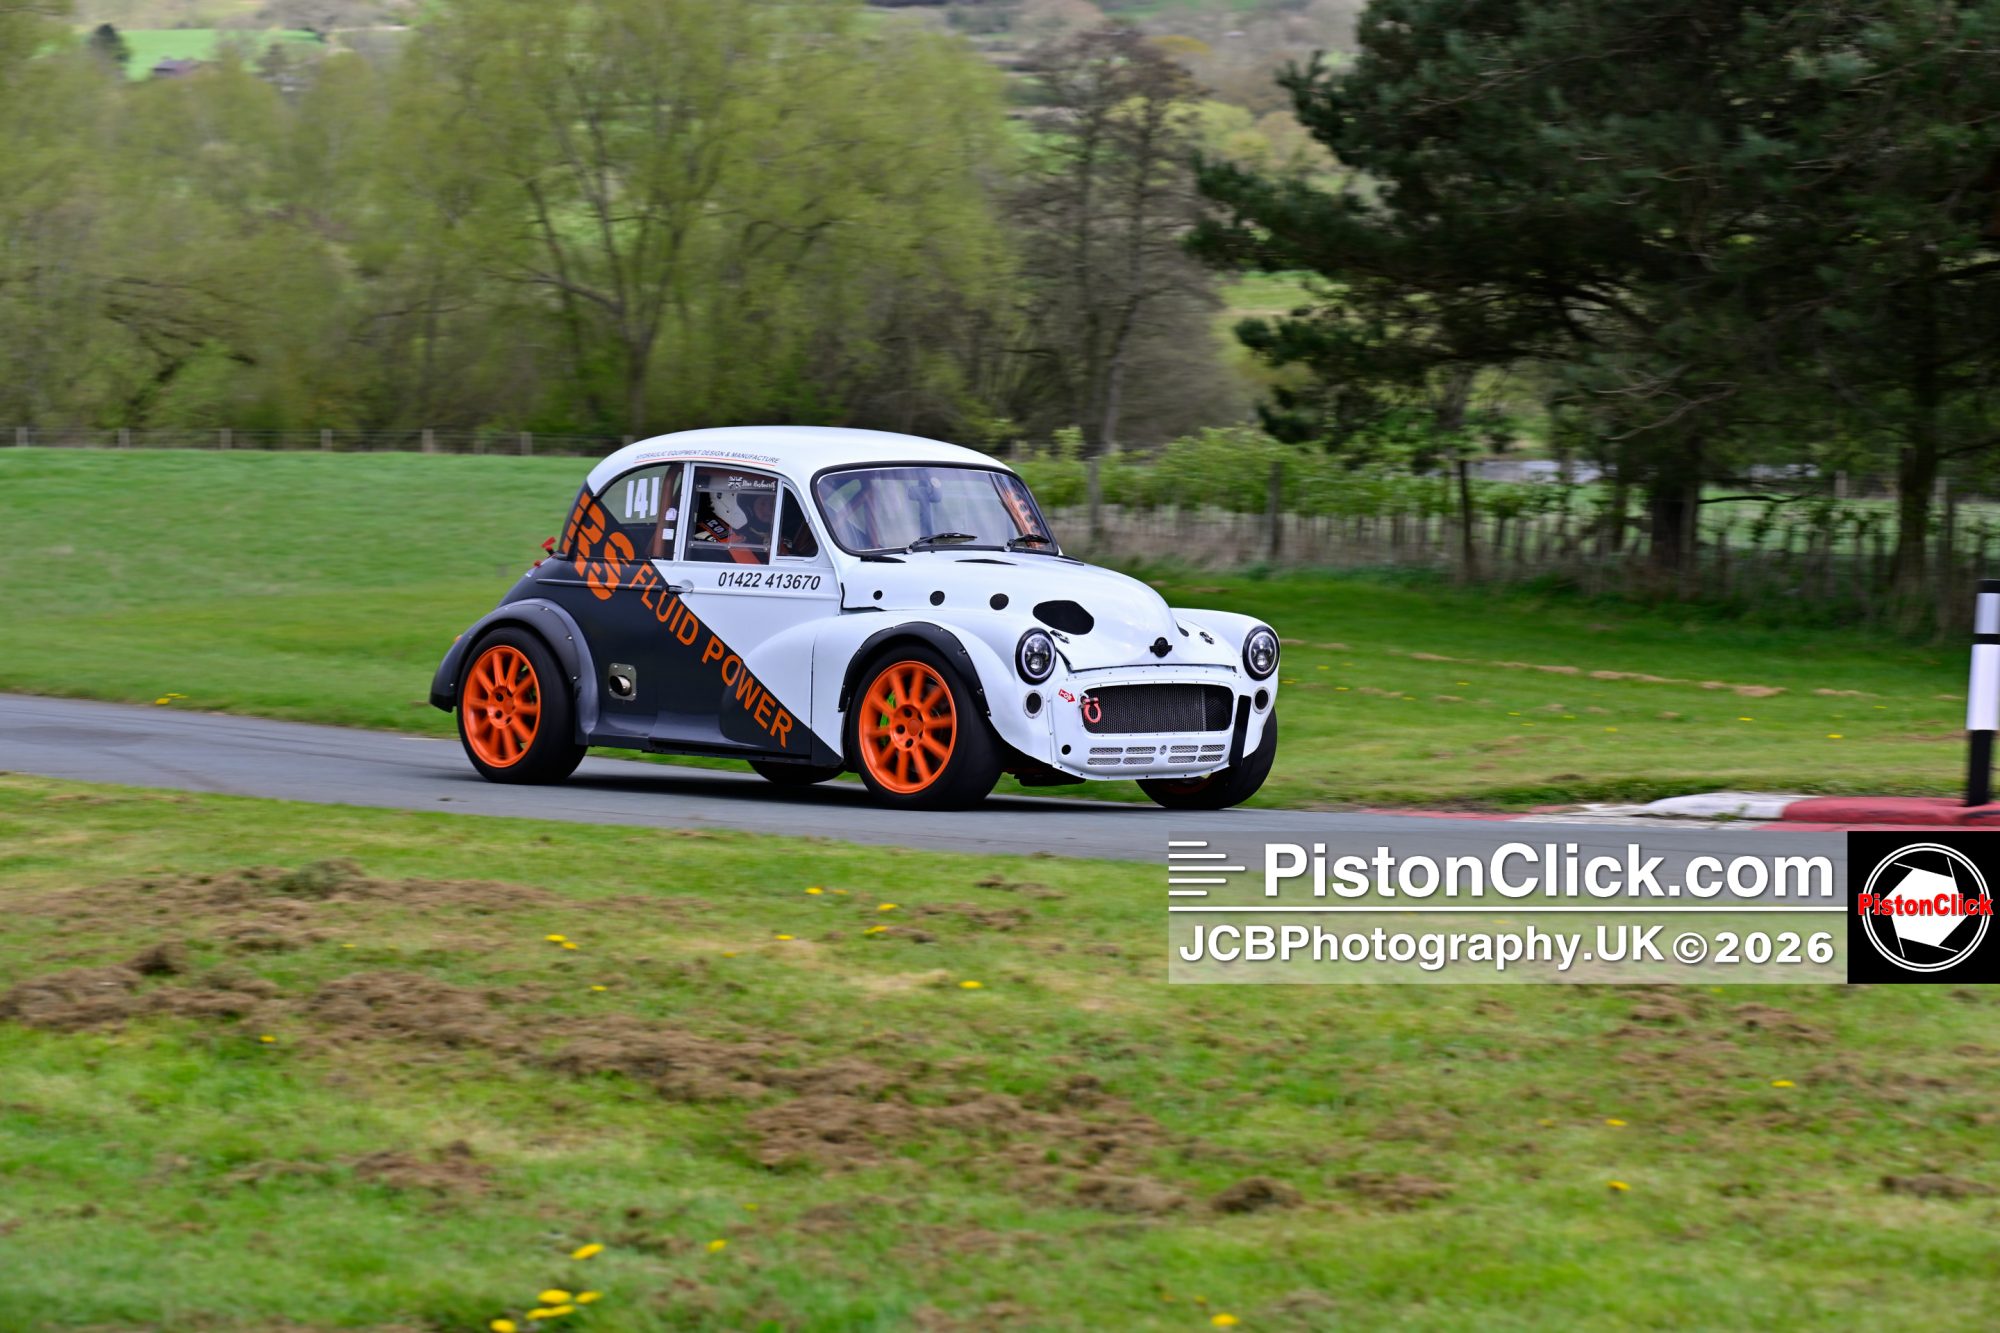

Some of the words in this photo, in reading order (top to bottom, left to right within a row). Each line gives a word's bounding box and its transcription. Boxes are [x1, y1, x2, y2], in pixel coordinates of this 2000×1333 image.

[701, 449, 725, 457] DESIGN
[730, 451, 781, 464] MANUFACTURE
[625, 477, 659, 519] 141
[718, 571, 762, 588] 01422
[765, 573, 821, 591] 413670
[628, 561, 699, 646] FLUID
[702, 635, 793, 748] POWER
